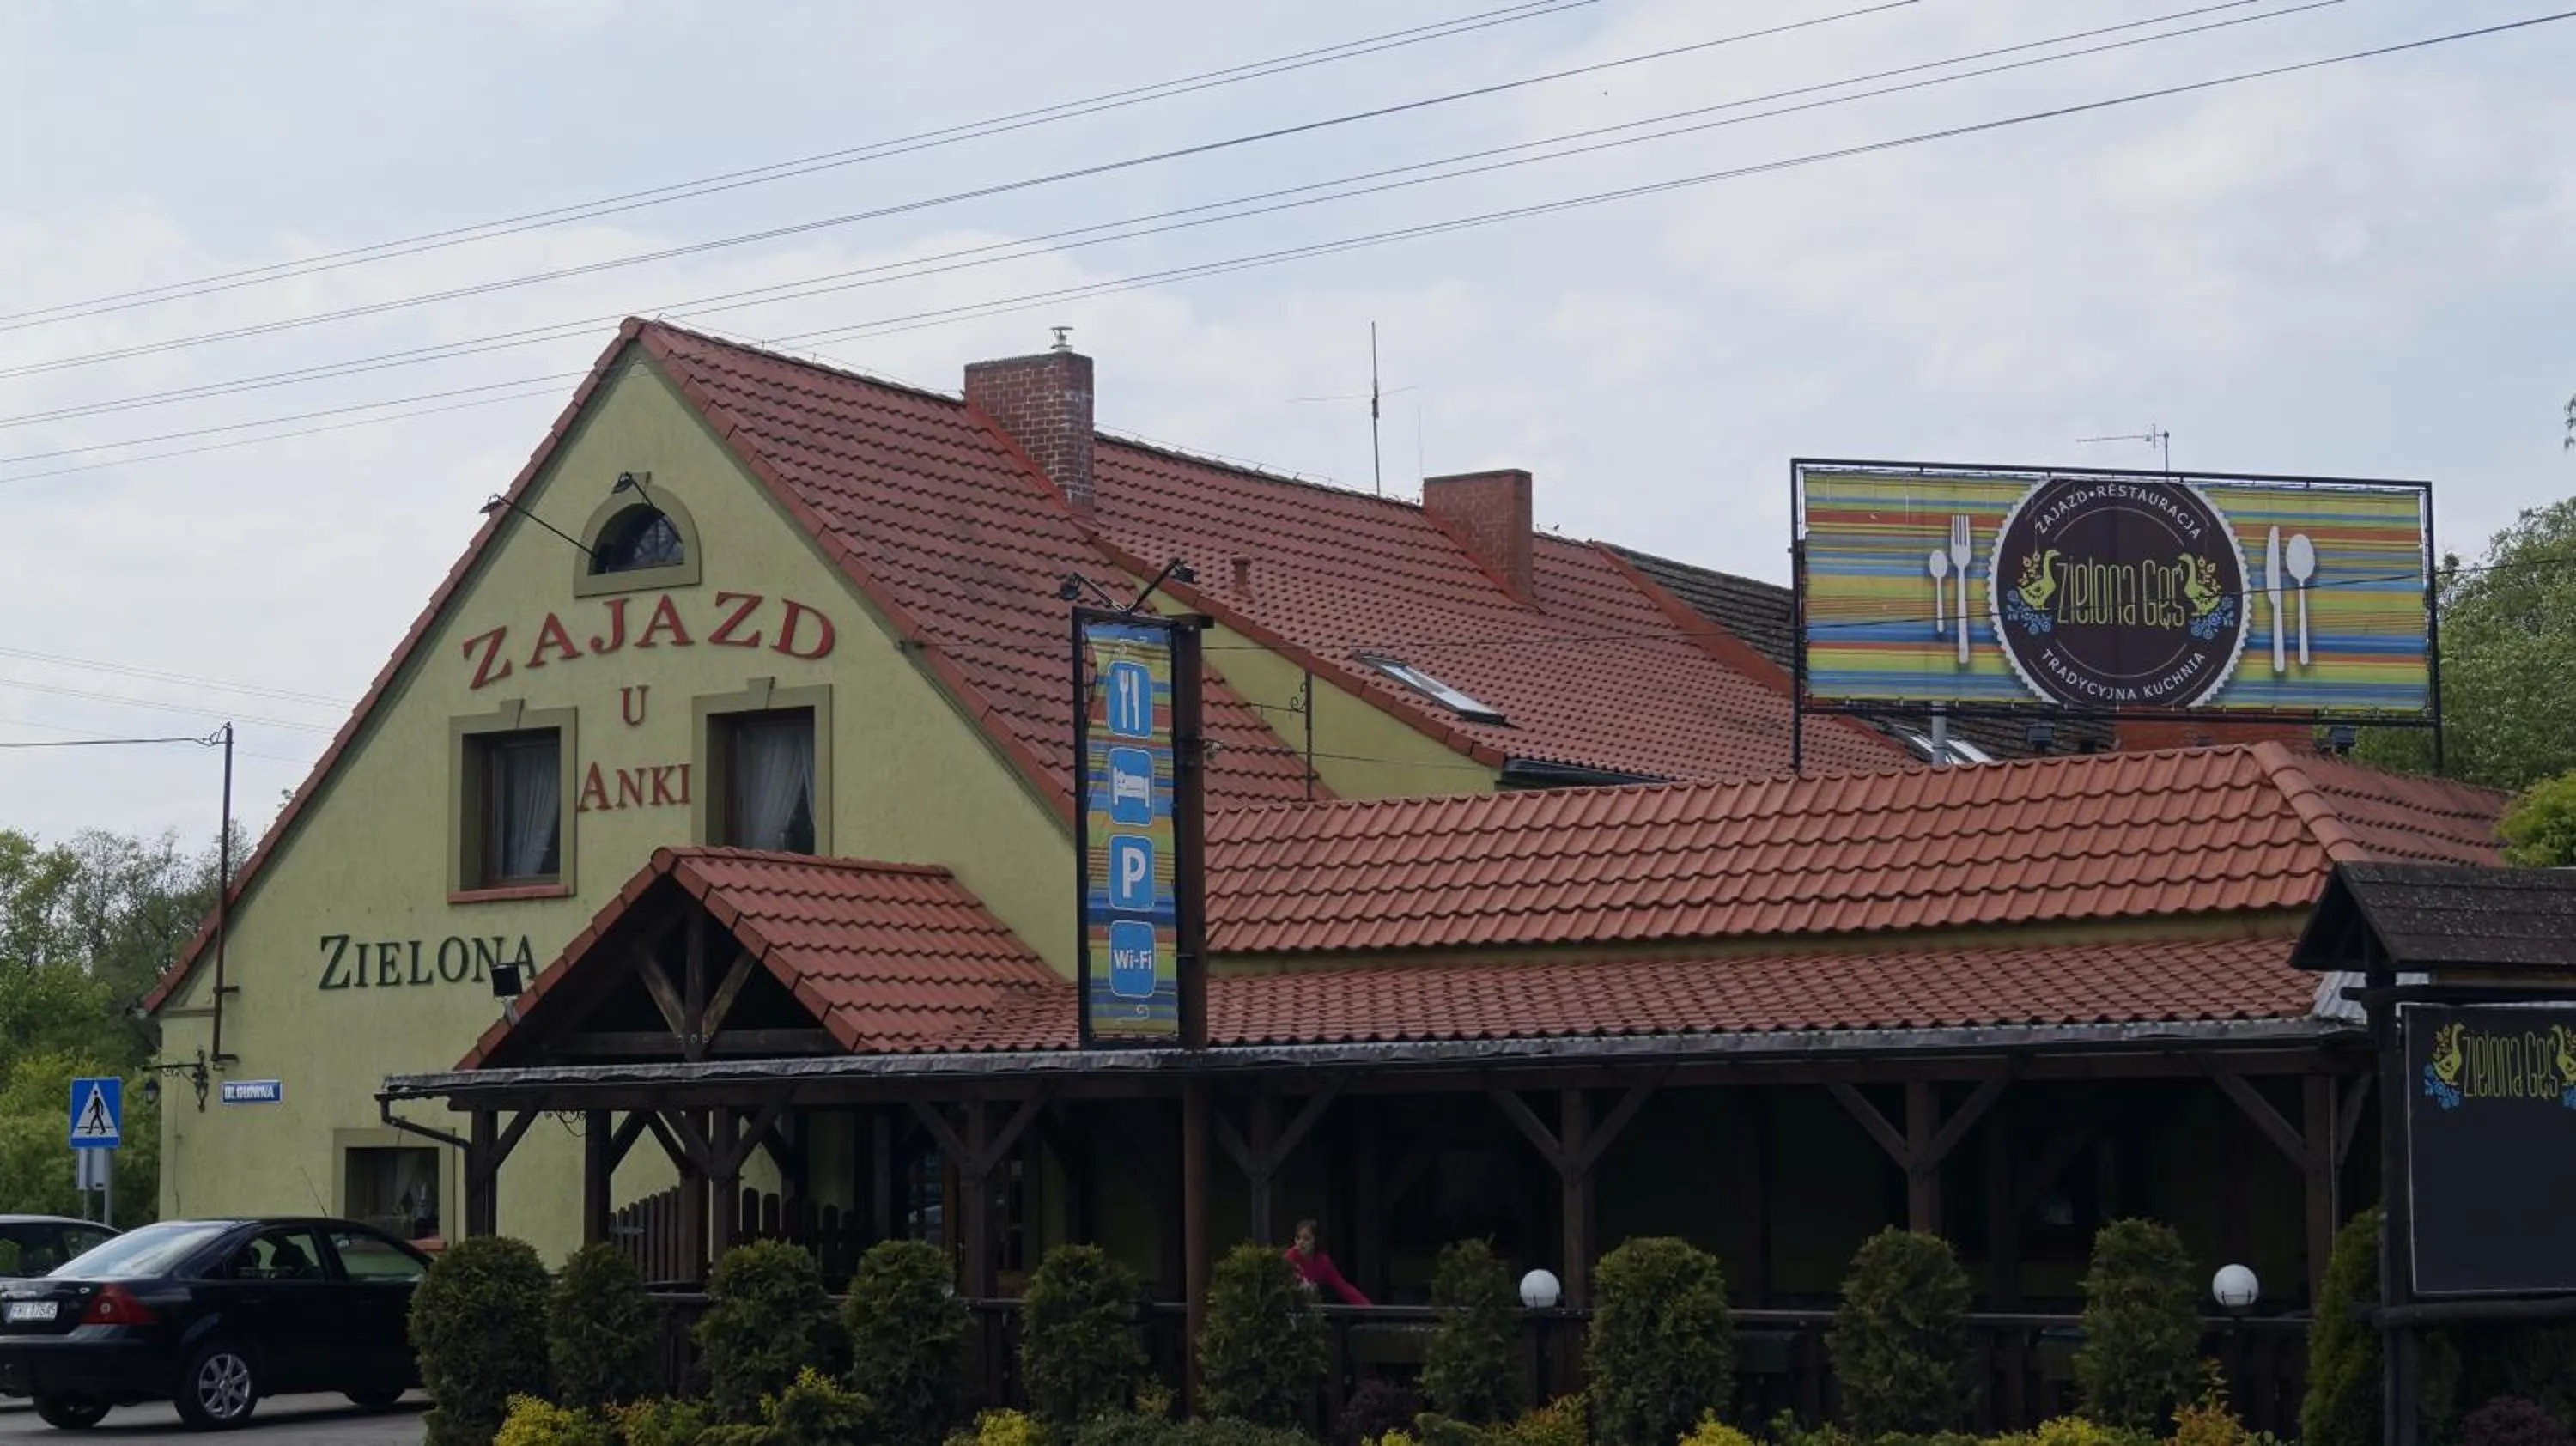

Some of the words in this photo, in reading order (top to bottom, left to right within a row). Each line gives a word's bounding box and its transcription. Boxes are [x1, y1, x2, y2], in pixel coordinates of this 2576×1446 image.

[2034, 490, 2087, 534] ZAJAZD
[2098, 483, 2201, 538] RESTAURACJA
[464, 591, 836, 690] ZAJAZD
[2042, 649, 2137, 701] TRADYCYJNA
[2142, 652, 2206, 696] KUCHNIA
[620, 686, 650, 726] U
[576, 762, 691, 812] ANKI
[1122, 846, 1146, 898] P
[319, 934, 537, 989] ZIELONA
[1113, 949, 1152, 969] Wi-Fi
